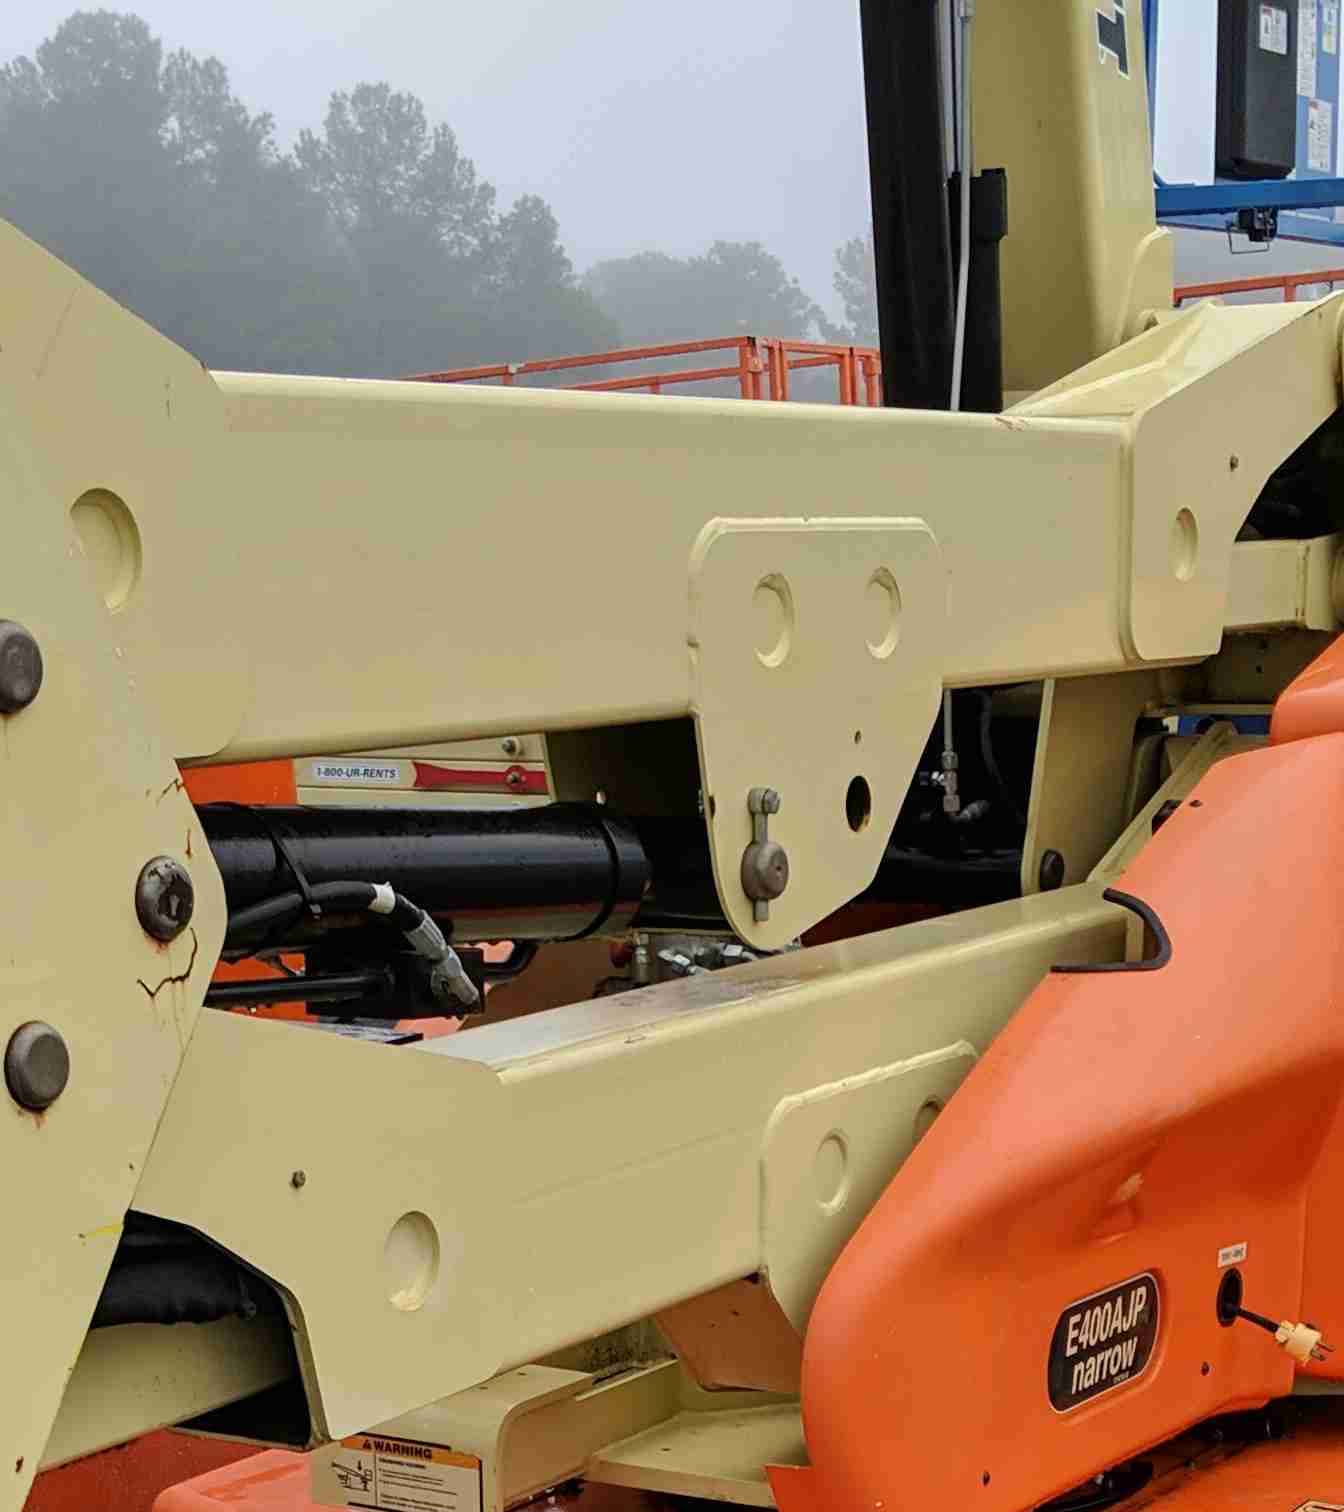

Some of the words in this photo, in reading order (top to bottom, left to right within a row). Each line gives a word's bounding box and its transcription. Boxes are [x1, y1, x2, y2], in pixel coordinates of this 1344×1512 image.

[317, 767, 397, 778] 1-800-UR-RENTS
[1066, 1286, 1147, 1357] E400AJP
[1071, 1336, 1138, 1395] narrow
[374, 1440, 433, 1460] WARNING
